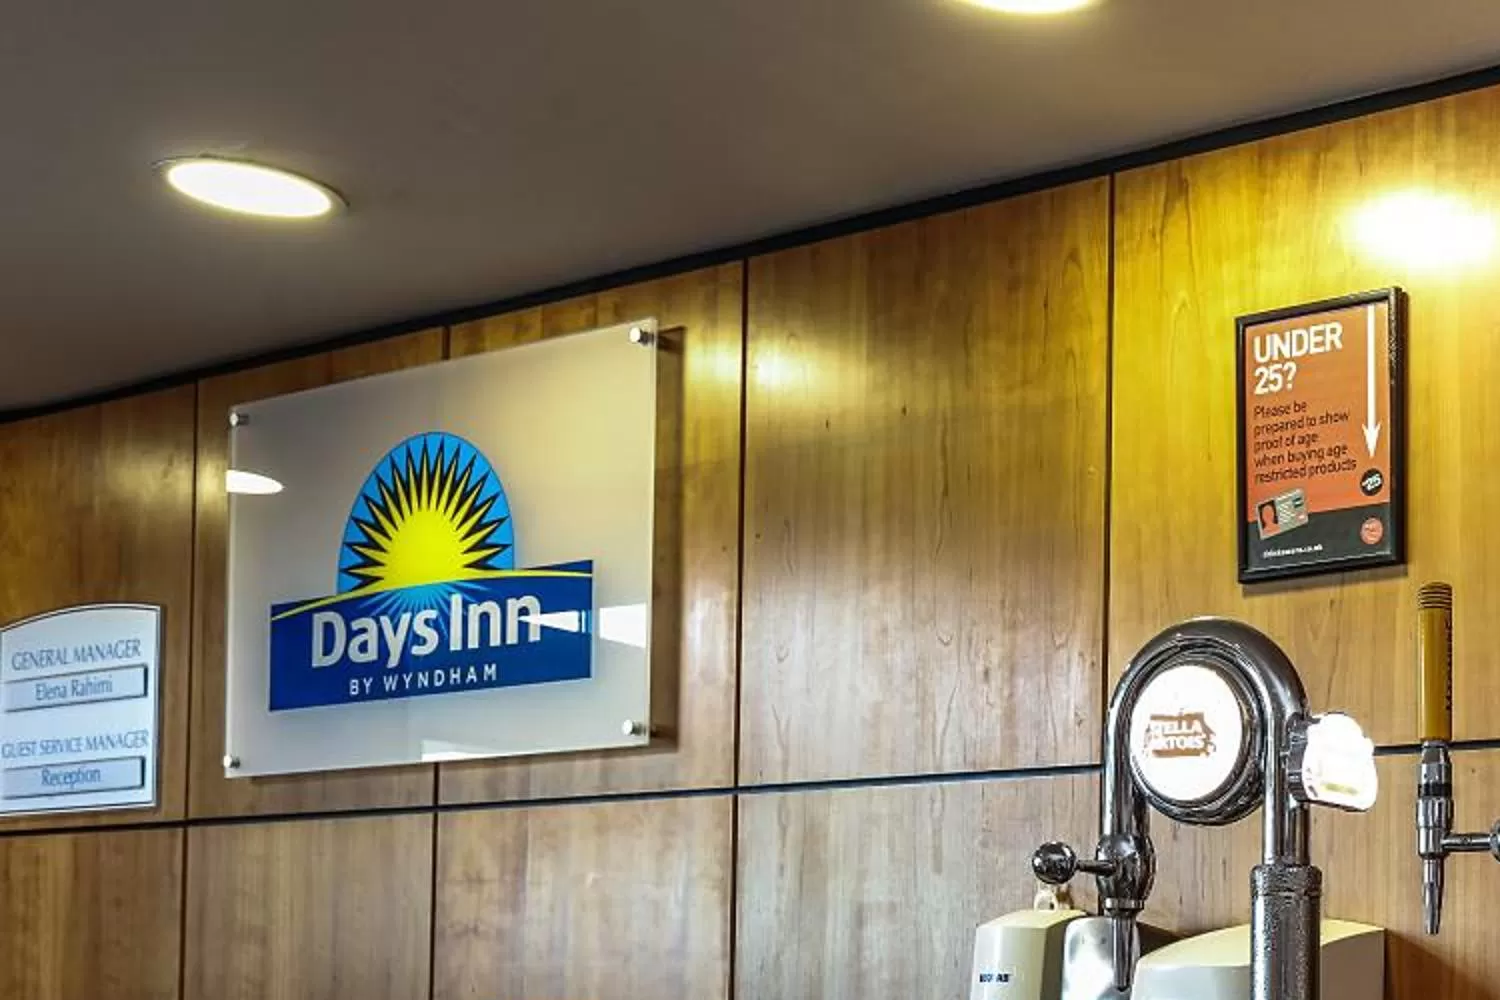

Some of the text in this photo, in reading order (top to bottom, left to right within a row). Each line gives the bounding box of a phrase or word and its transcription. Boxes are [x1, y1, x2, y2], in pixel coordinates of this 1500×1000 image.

[1253, 321, 1343, 363] UNDER
[1254, 361, 1297, 395] 25?
[1254, 400, 1307, 420] Please be
[1254, 408, 1350, 438] prepared to show
[1254, 433, 1319, 454] proof of age
[1254, 443, 1349, 468] when buying age
[1255, 458, 1357, 485] restricted products
[311, 593, 542, 669] Days Inn
[11, 638, 142, 672] GENERAL MANAGER
[35, 682, 68, 702] Elena
[349, 662, 498, 696] BY WYNDHAM
[2, 729, 149, 758] GUEST SERVICE MANAGER
[41, 766, 101, 789] Reception
